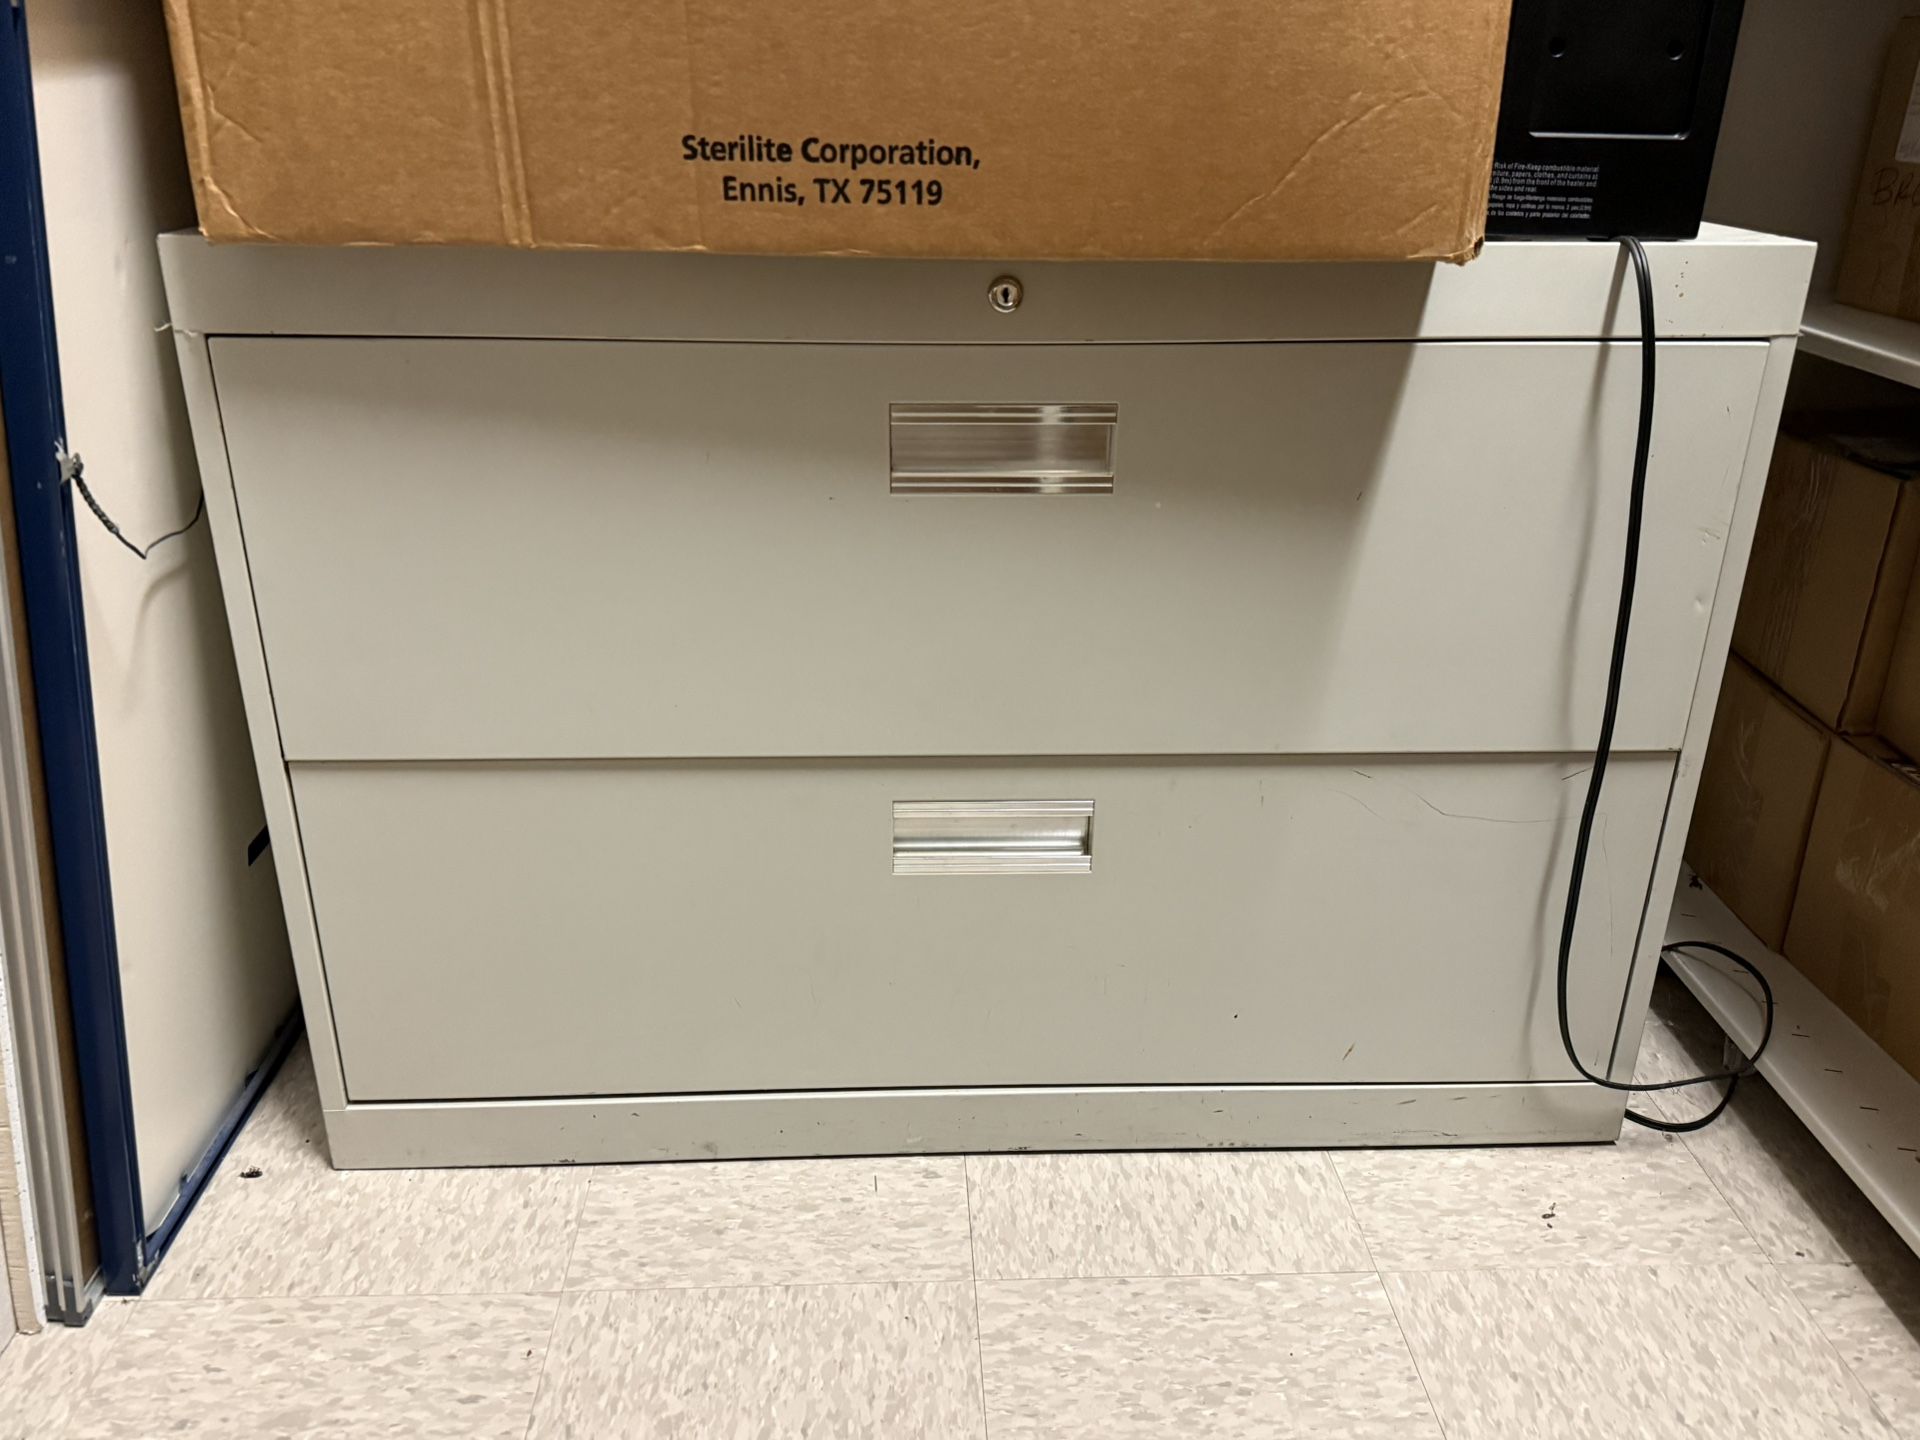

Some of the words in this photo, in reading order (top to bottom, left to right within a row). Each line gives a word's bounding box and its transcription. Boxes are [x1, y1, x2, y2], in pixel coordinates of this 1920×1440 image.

[681, 134, 793, 162] Sterilite
[801, 137, 981, 170] Corporation,
[722, 175, 806, 206] Ennis,
[813, 177, 852, 204] TX
[859, 178, 943, 205] 75119
